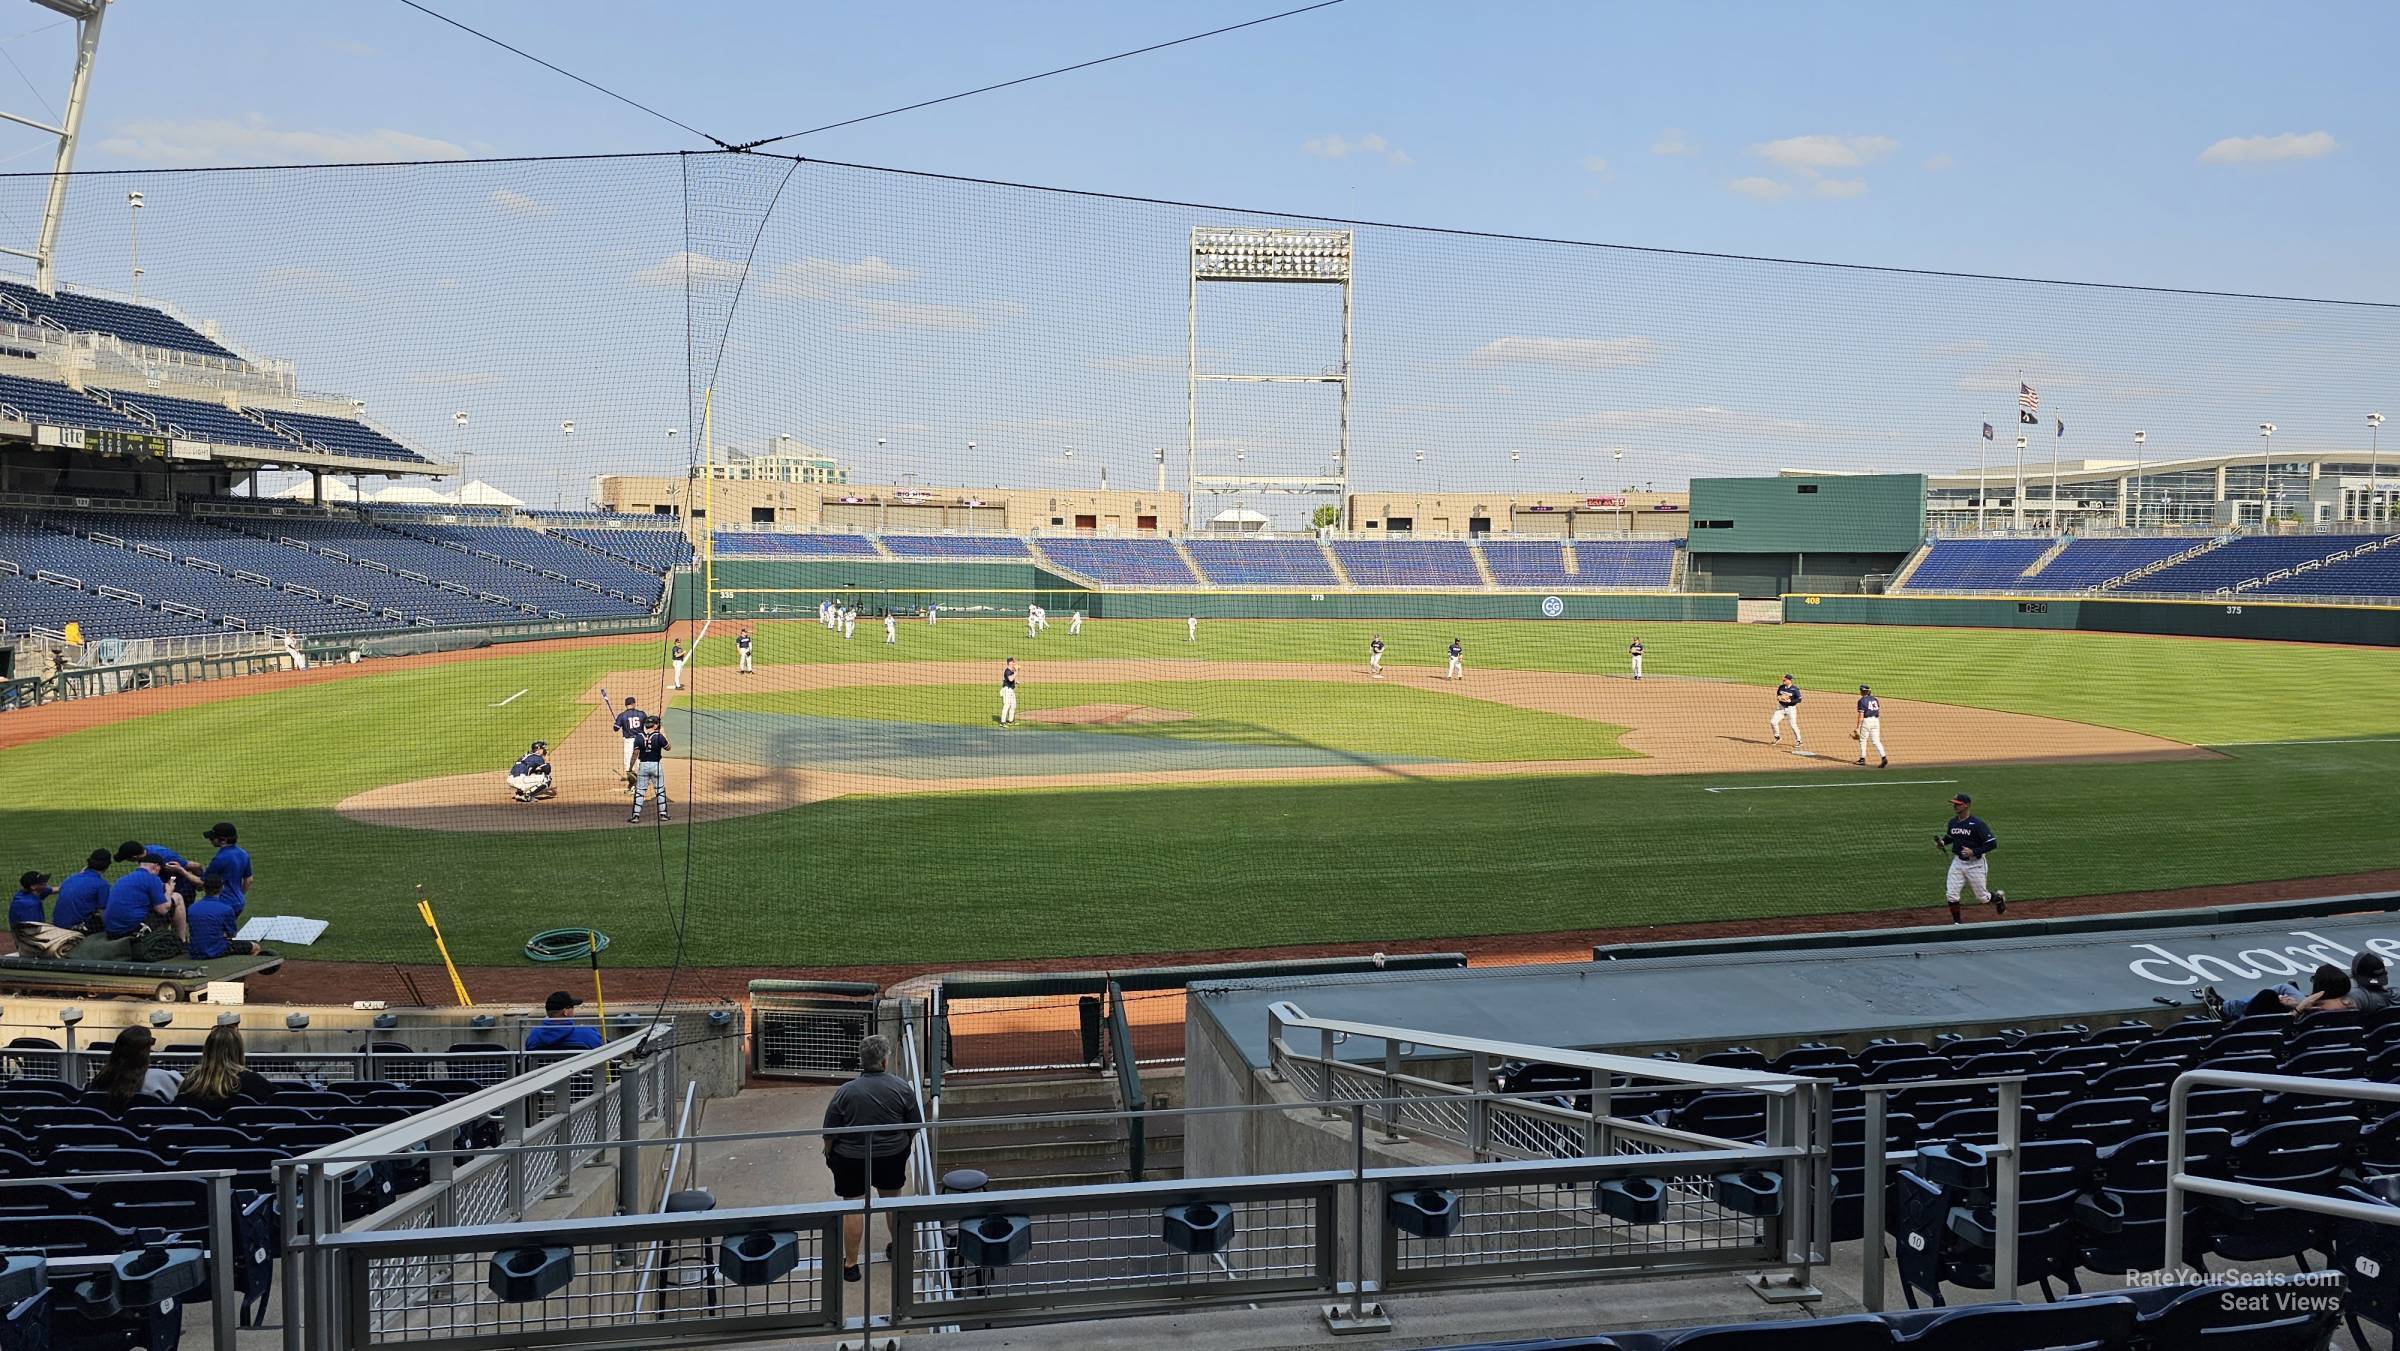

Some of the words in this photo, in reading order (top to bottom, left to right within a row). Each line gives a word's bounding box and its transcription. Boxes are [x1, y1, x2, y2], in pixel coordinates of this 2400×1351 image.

[1804, 597, 1820, 605] 408
[2026, 603, 2047, 613] 0:20
[2226, 606, 2242, 614] 375
[1868, 700, 1879, 711] 43
[628, 716, 641, 730] 16
